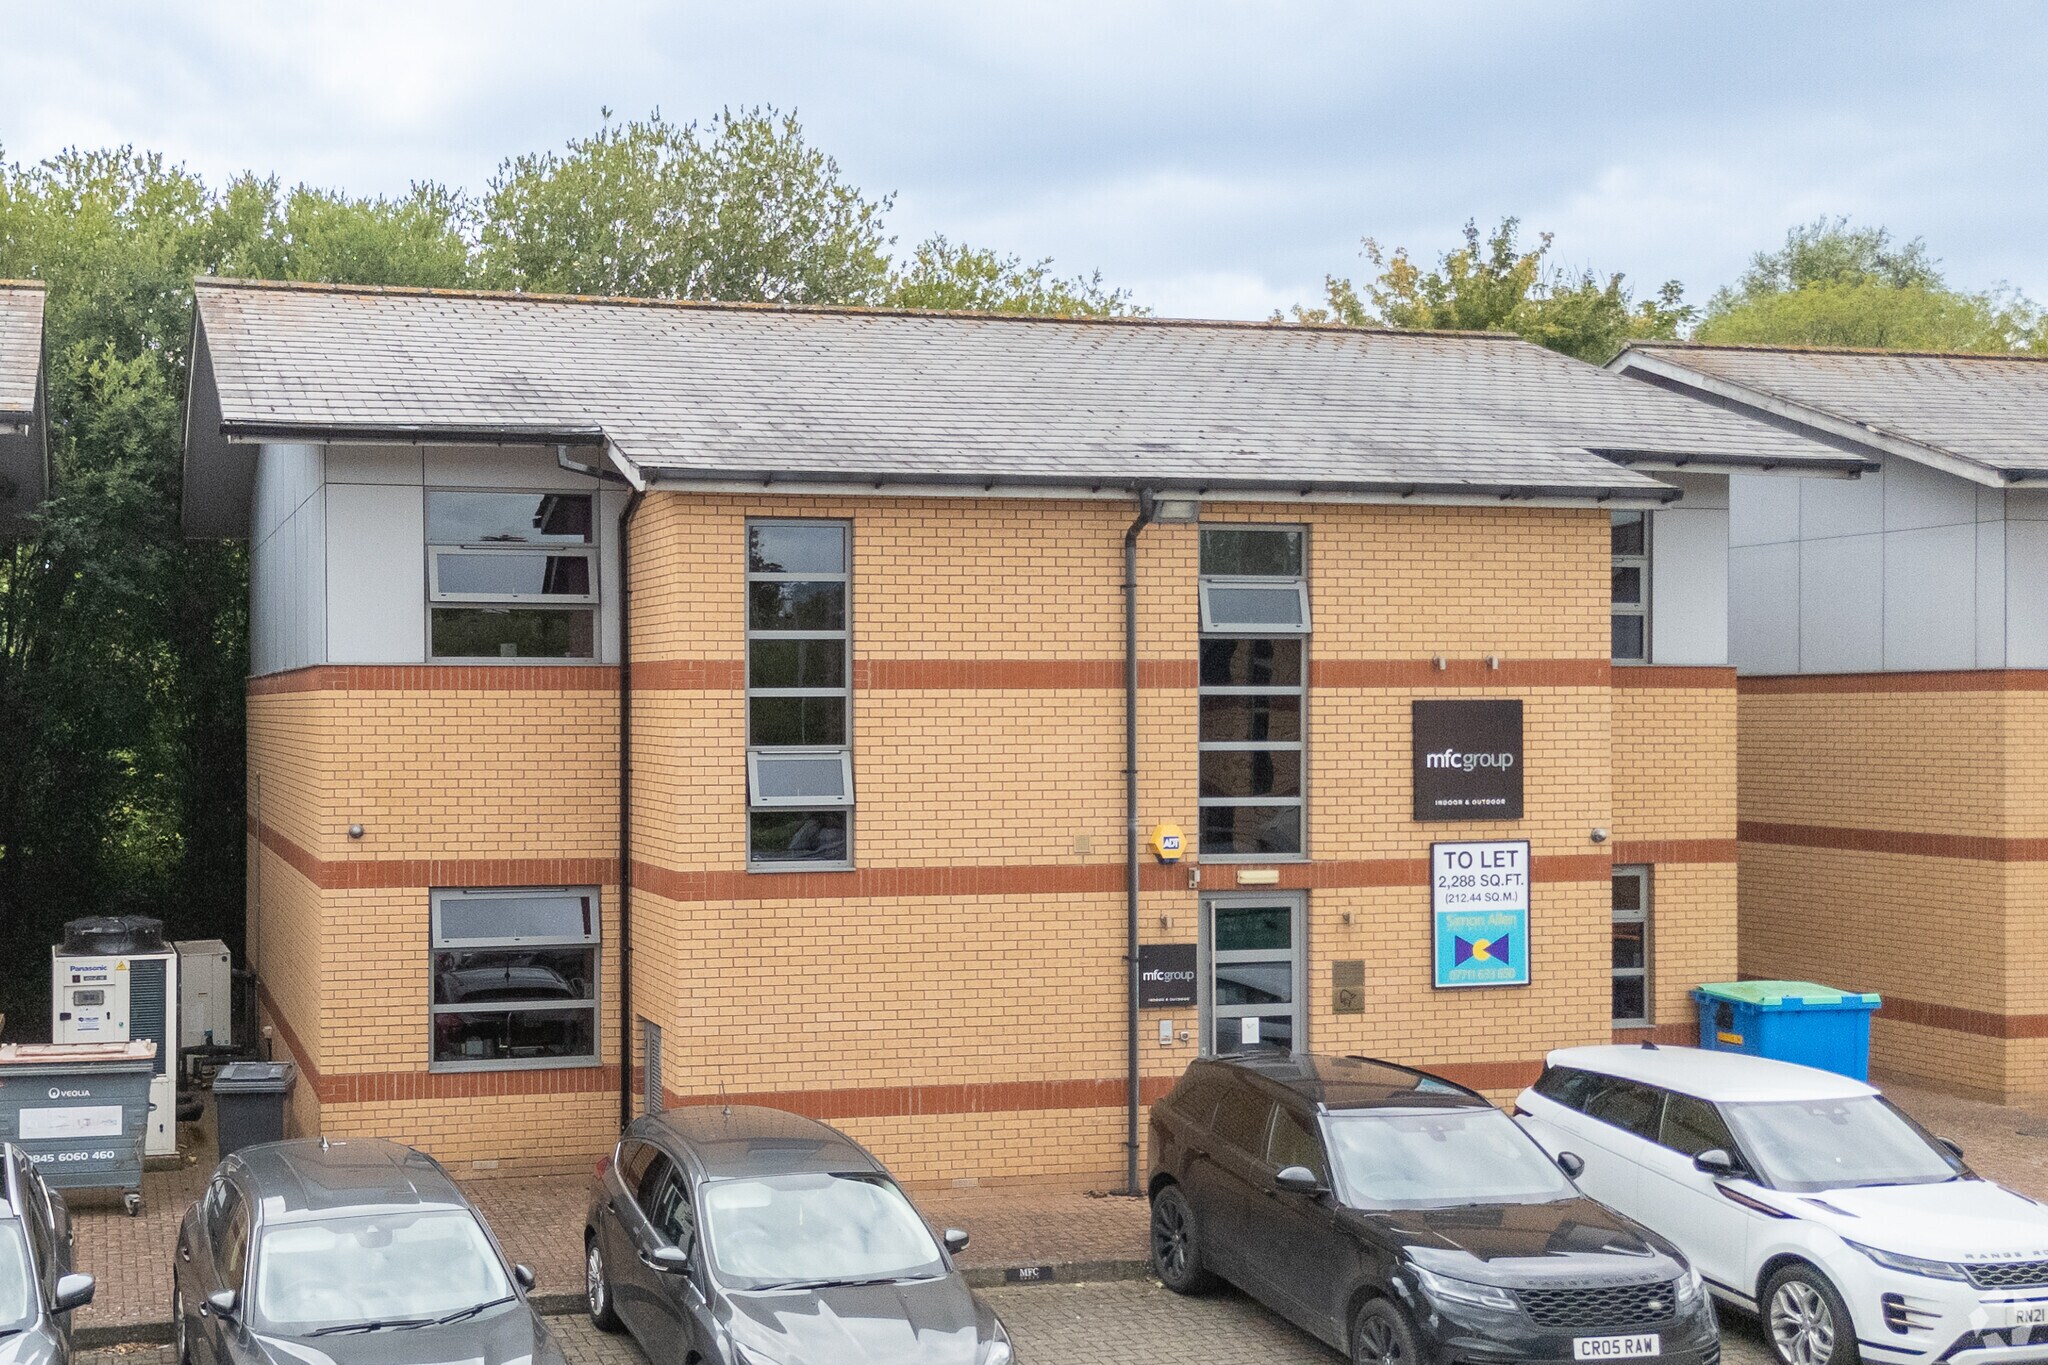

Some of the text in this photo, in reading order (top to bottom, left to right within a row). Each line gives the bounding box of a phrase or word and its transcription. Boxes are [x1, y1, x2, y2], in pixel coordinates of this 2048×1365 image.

[1471, 798, 1506, 806] OUTDOOR
[1164, 837, 1179, 848] ADT
[1443, 850, 1519, 869] TO LET
[1438, 873, 1524, 890] 2,288 SQ.FT.
[1445, 891, 1518, 904] (212.44 SQ.M.)
[58, 1151, 89, 1162] 6060
[91, 1150, 115, 1160] 460
[1965, 1250, 2022, 1259] RANGE
[1020, 1268, 1039, 1276] MFC
[2016, 1309, 2045, 1323] RN21
[1625, 1338, 1652, 1354] RAW
